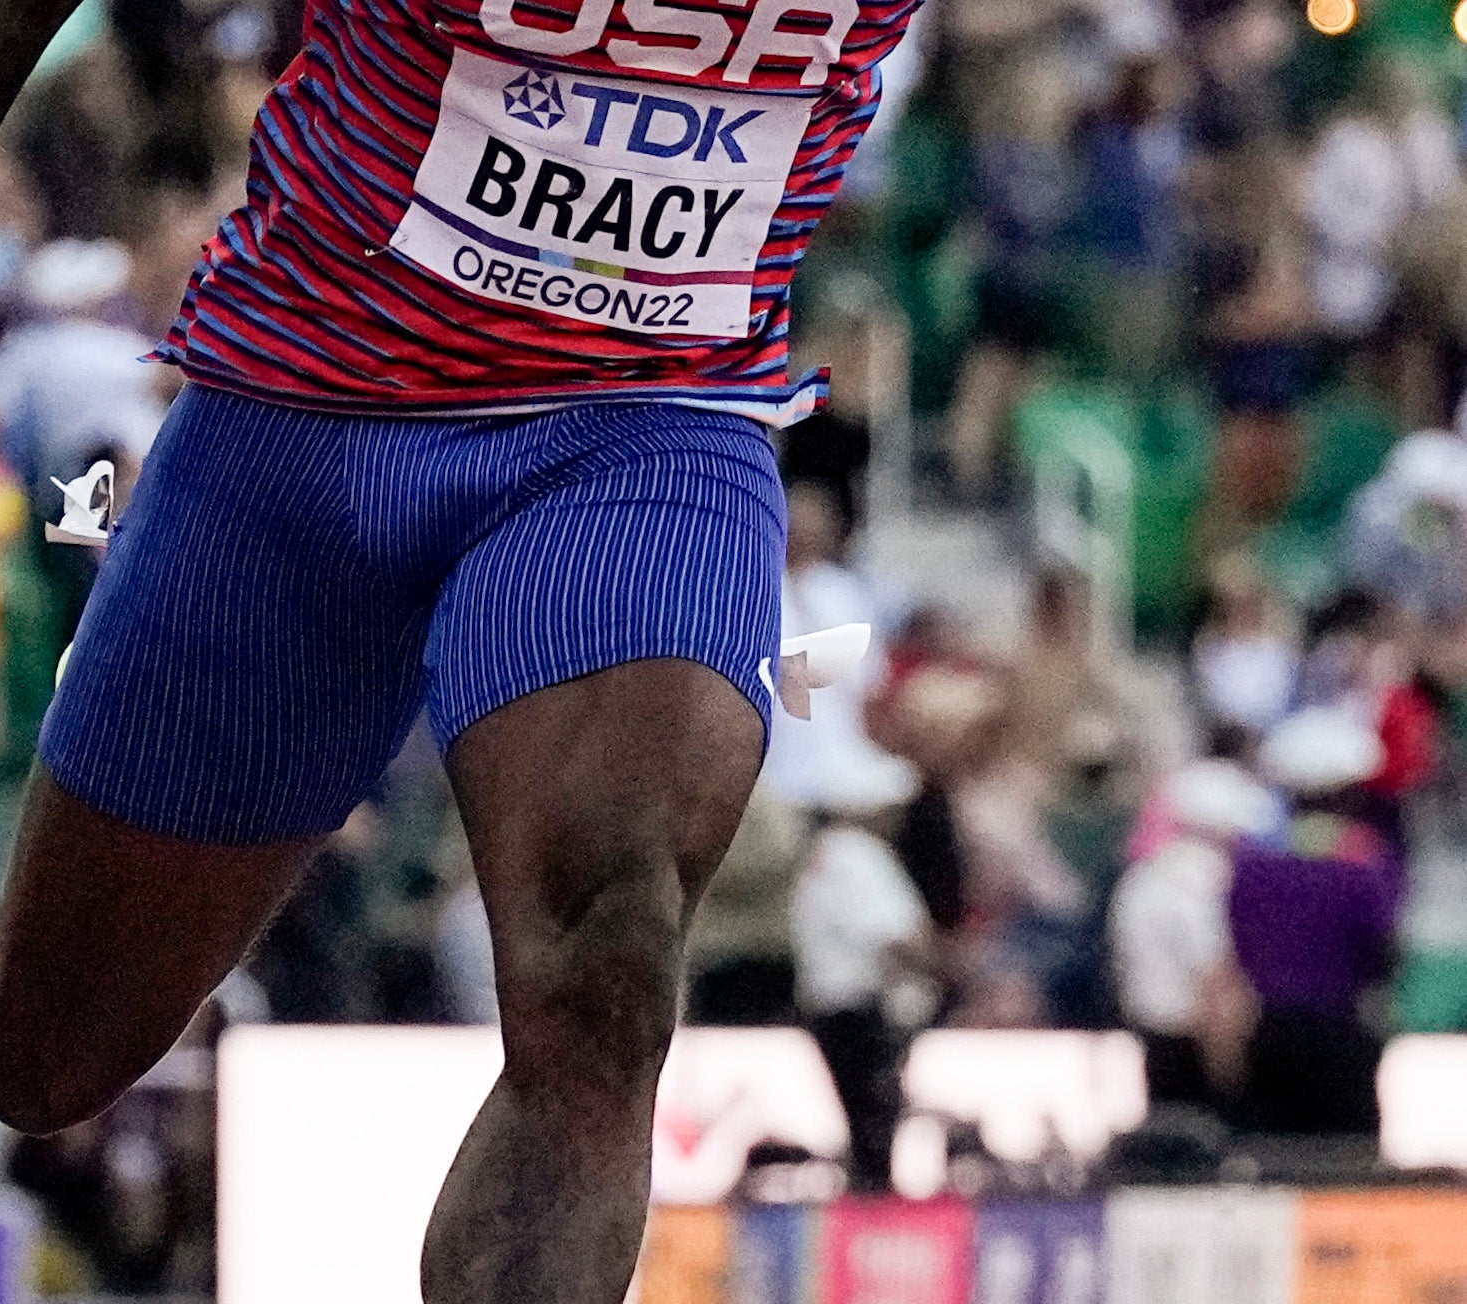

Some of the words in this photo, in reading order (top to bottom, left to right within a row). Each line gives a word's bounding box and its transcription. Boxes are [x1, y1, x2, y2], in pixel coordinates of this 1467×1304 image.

[571, 83, 768, 163] TDK
[466, 135, 744, 258] BRACY
[452, 245, 693, 327] OREGON22
